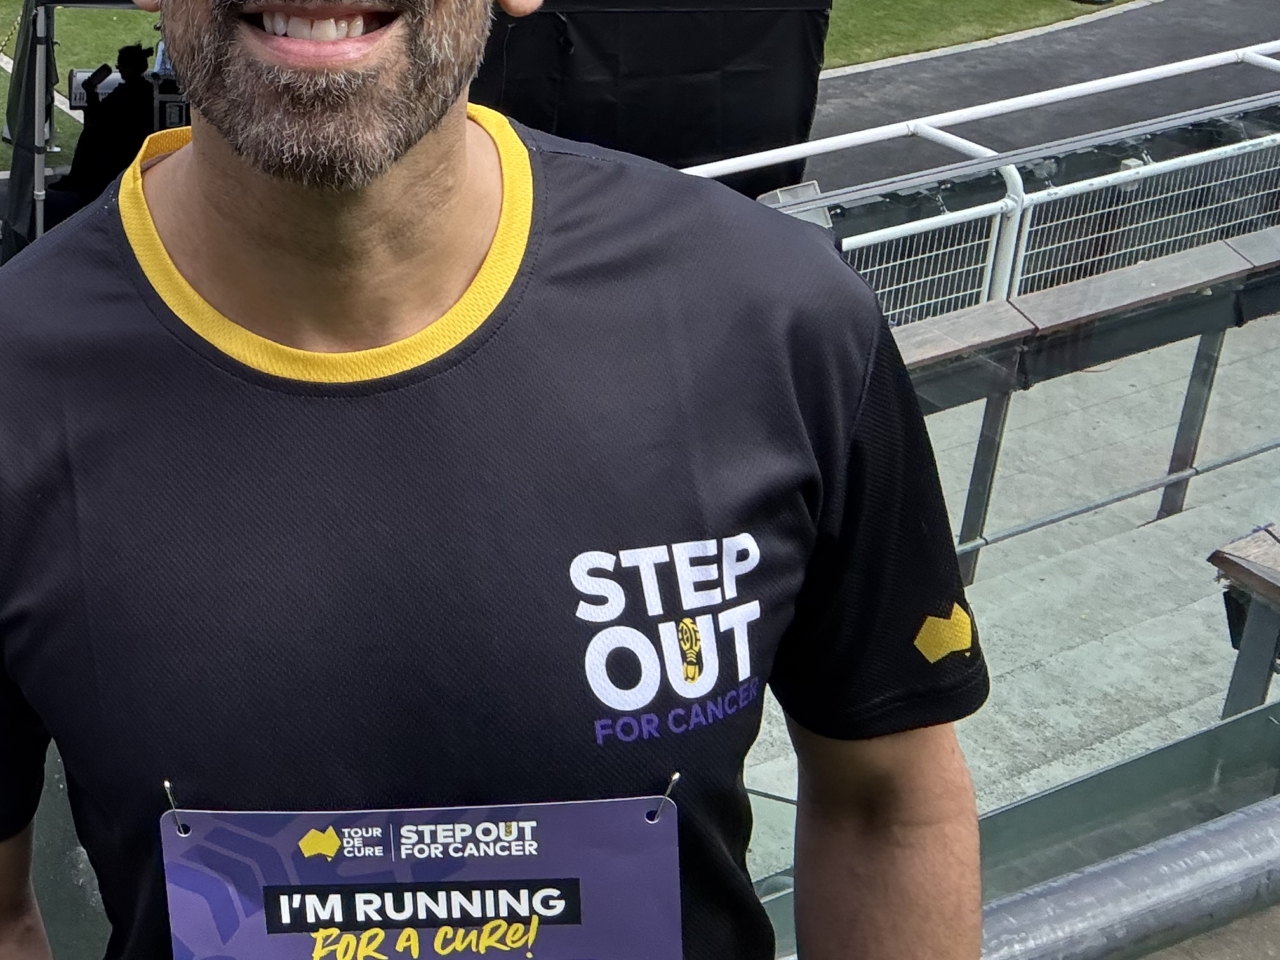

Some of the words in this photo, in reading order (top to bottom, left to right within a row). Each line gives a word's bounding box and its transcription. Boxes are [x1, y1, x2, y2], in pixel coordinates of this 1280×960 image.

[569, 532, 760, 623] STEP
[584, 600, 761, 712] OUT
[594, 713, 660, 746] FOR
[667, 676, 760, 734] CANCER
[341, 827, 382, 838] TOUR
[342, 838, 363, 848] DE
[343, 846, 384, 857] CURE
[400, 844, 444, 859] FOR
[448, 841, 538, 858] CANCER
[280, 893, 343, 924] I'M
[355, 887, 565, 923] RUNNING
[310, 927, 389, 960] FOR
[395, 927, 419, 959] A
